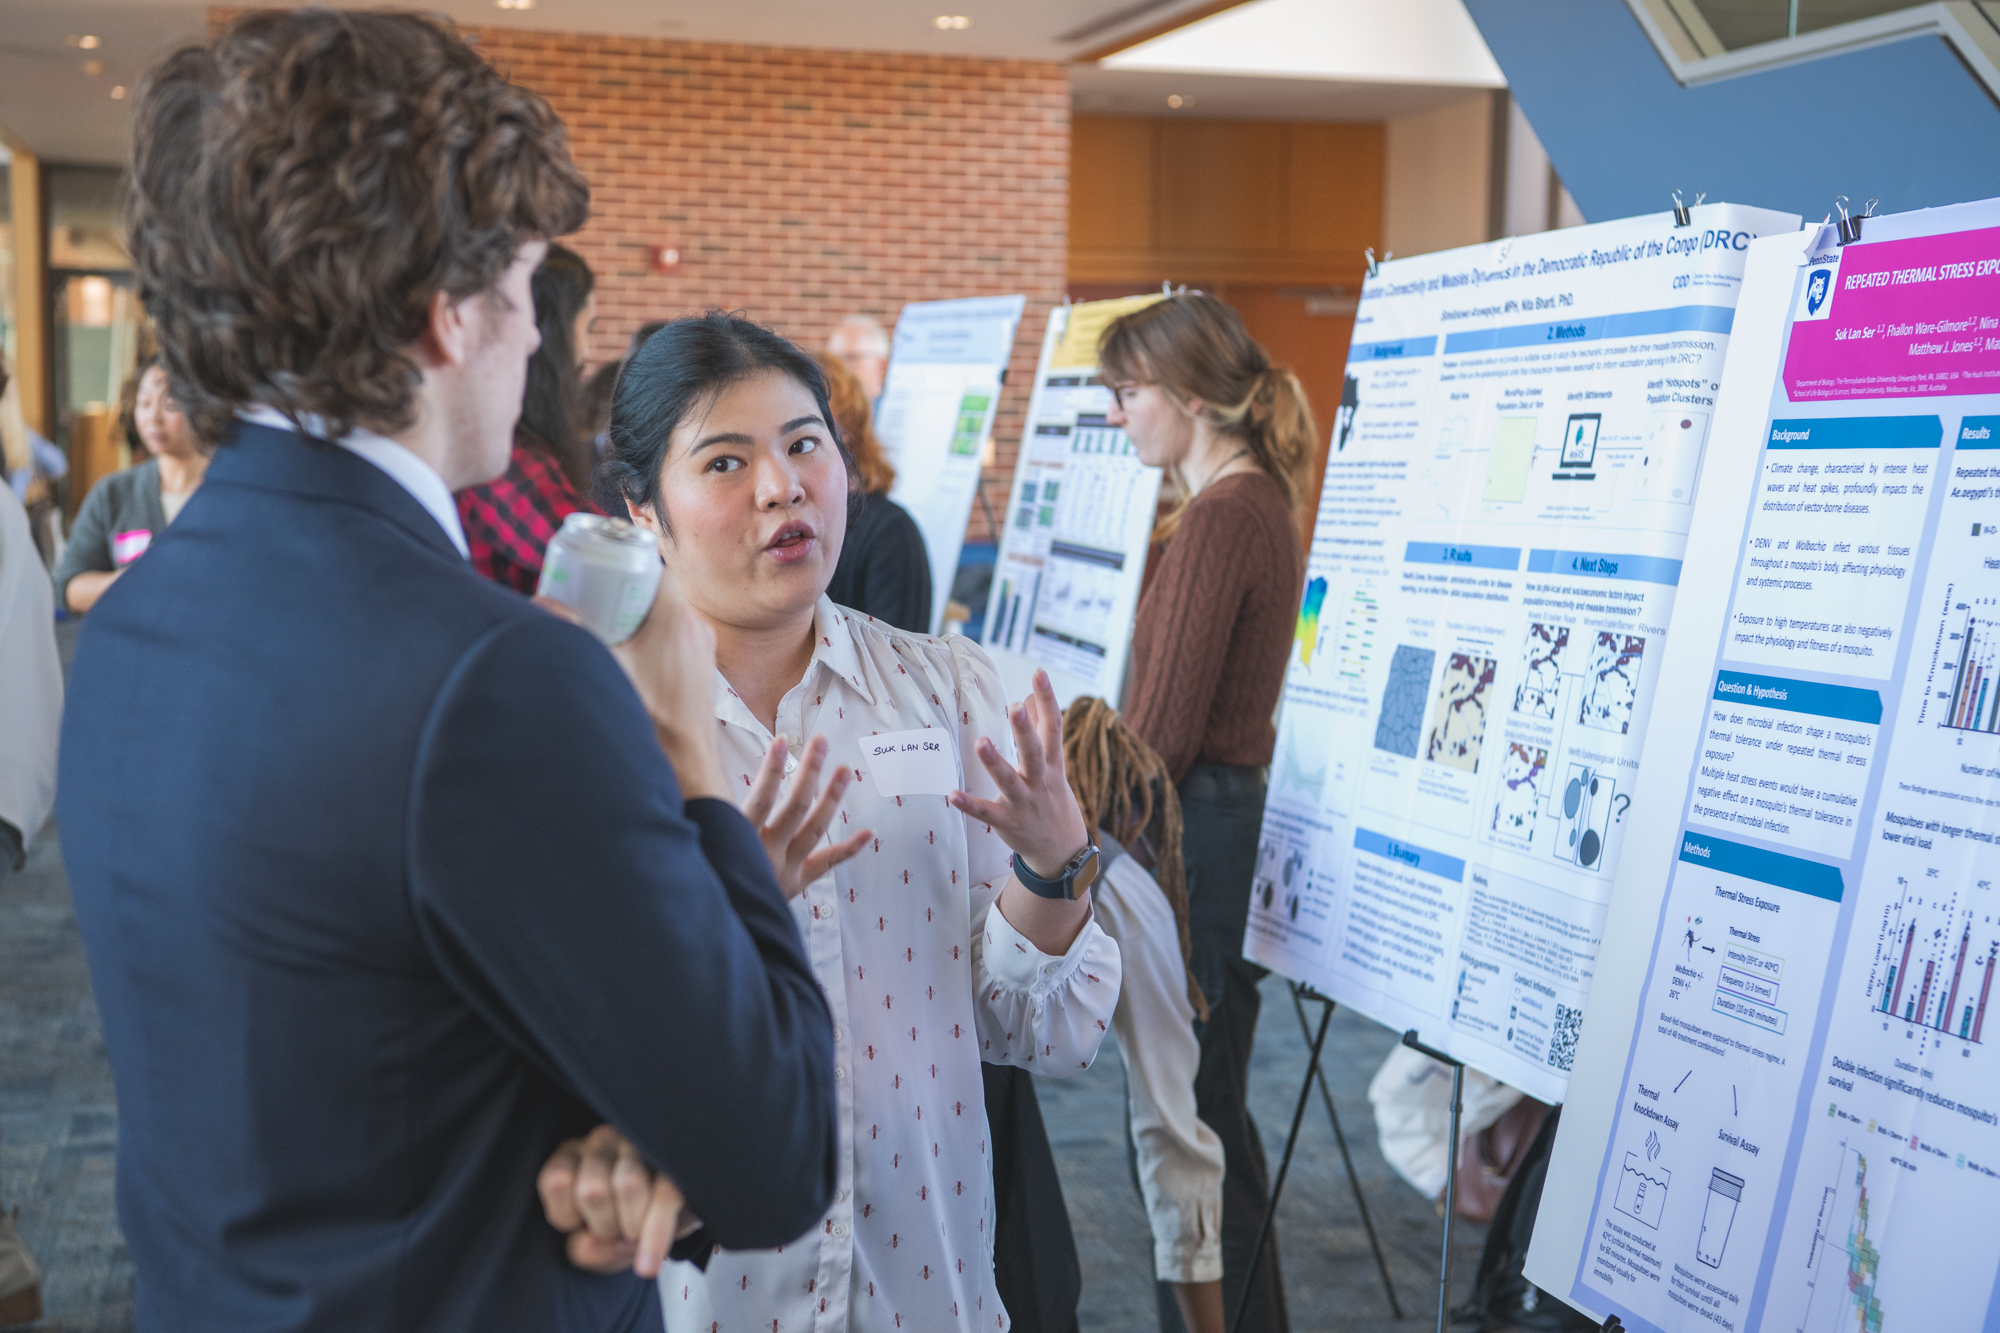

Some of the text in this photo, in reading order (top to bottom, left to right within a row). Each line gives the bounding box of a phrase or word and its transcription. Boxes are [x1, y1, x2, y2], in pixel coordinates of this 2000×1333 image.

[1524, 262, 1535, 276] the
[1538, 253, 1588, 274] Democratic
[1589, 248, 1631, 268] Republic
[1634, 244, 1646, 259] of
[1647, 242, 1663, 257] the
[1666, 236, 1698, 257] Congo
[1808, 255, 1839, 266] PennState
[1845, 271, 1890, 290] REPEATED
[1891, 268, 1937, 285] THERMAL
[1938, 261, 1975, 280] STRESS
[1556, 323, 1586, 338] Methods
[1835, 328, 1848, 341] Suk
[1848, 328, 1861, 339] Lan
[1862, 326, 1875, 338] Ser
[1887, 324, 1913, 337] Fhallon
[1979, 316, 1999, 330] Nina
[1908, 342, 1942, 356] Matthew
[1672, 392, 1714, 406] Clusters
[1772, 429, 1810, 441] Background
[1961, 427, 1991, 440] Results
[1771, 463, 1928, 475] Climate change, characterized by intense heat
[1955, 467, 1988, 479] Repeated
[1767, 482, 1924, 496] waves and heat spikes, profoundly impacts the
[1763, 501, 1870, 514] distribution of vector-borne diseases.
[1755, 538, 1772, 548] DENV
[1778, 540, 1789, 550] and
[1833, 542, 1851, 553] infect
[1857, 543, 1880, 554] various
[1888, 544, 1910, 557] tissues
[1580, 557, 1598, 573] Next
[1598, 559, 1618, 576] Steps
[1750, 556, 1783, 569] throughout
[1790, 559, 1822, 573] mosquito's
[1824, 560, 1840, 574] body,
[1842, 562, 1868, 576] affecting
[1870, 564, 1906, 579] physiology
[1746, 575, 1813, 590] and systemic processes.
[1624, 591, 1644, 602] impact
[1638, 624, 1666, 636] Rivers
[1739, 612, 1893, 640] Exposure to high temperatures can also negatively
[1734, 630, 1874, 658] impact the physiology and fitness of mosquito.
[1718, 680, 1788, 701] Question & Hypothesis
[1713, 710, 1727, 722] How
[1730, 713, 1743, 725] does
[1747, 715, 1774, 729] microbial
[1776, 719, 1803, 734] infection
[1806, 724, 1824, 739] shape
[1834, 729, 1872, 746] mosquito's
[873, 746, 896, 755] SUK
[1705, 750, 1735, 763] exposure?
[1709, 729, 1867, 767] thermal tolerance under repeated thermal stress
[1617, 756, 1639, 769] Units
[1701, 765, 1725, 780] Multiple
[1726, 770, 1739, 783] heat
[1740, 774, 1757, 787] stress
[1759, 777, 1778, 791] events
[1780, 779, 1799, 794] would
[1800, 784, 1815, 799] have
[1822, 788, 1858, 807] cumulative
[1614, 794, 1631, 823] ?
[1698, 786, 1721, 799] negative
[1722, 789, 1739, 803] effect
[1740, 795, 1748, 805] on
[1755, 797, 1787, 814] mosquito's
[1789, 802, 1812, 818] thermal
[1815, 810, 1844, 825] tolerance
[1845, 817, 1853, 827] in
[1694, 803, 1790, 834] the presence of microbial infection.
[1882, 829, 1902, 842] lower
[1684, 842, 1711, 858] Methods
[1715, 885, 1780, 913] Thermal Stress Exposure
[1832, 1055, 1855, 1073] Double
[1856, 1064, 1883, 1084] infection
[1637, 1083, 1660, 1101] Thermal
[1828, 1076, 1854, 1092] survival
[1633, 1101, 1679, 1132] Knockdown Assay
[1717, 1128, 1760, 1157] Survival Assay
